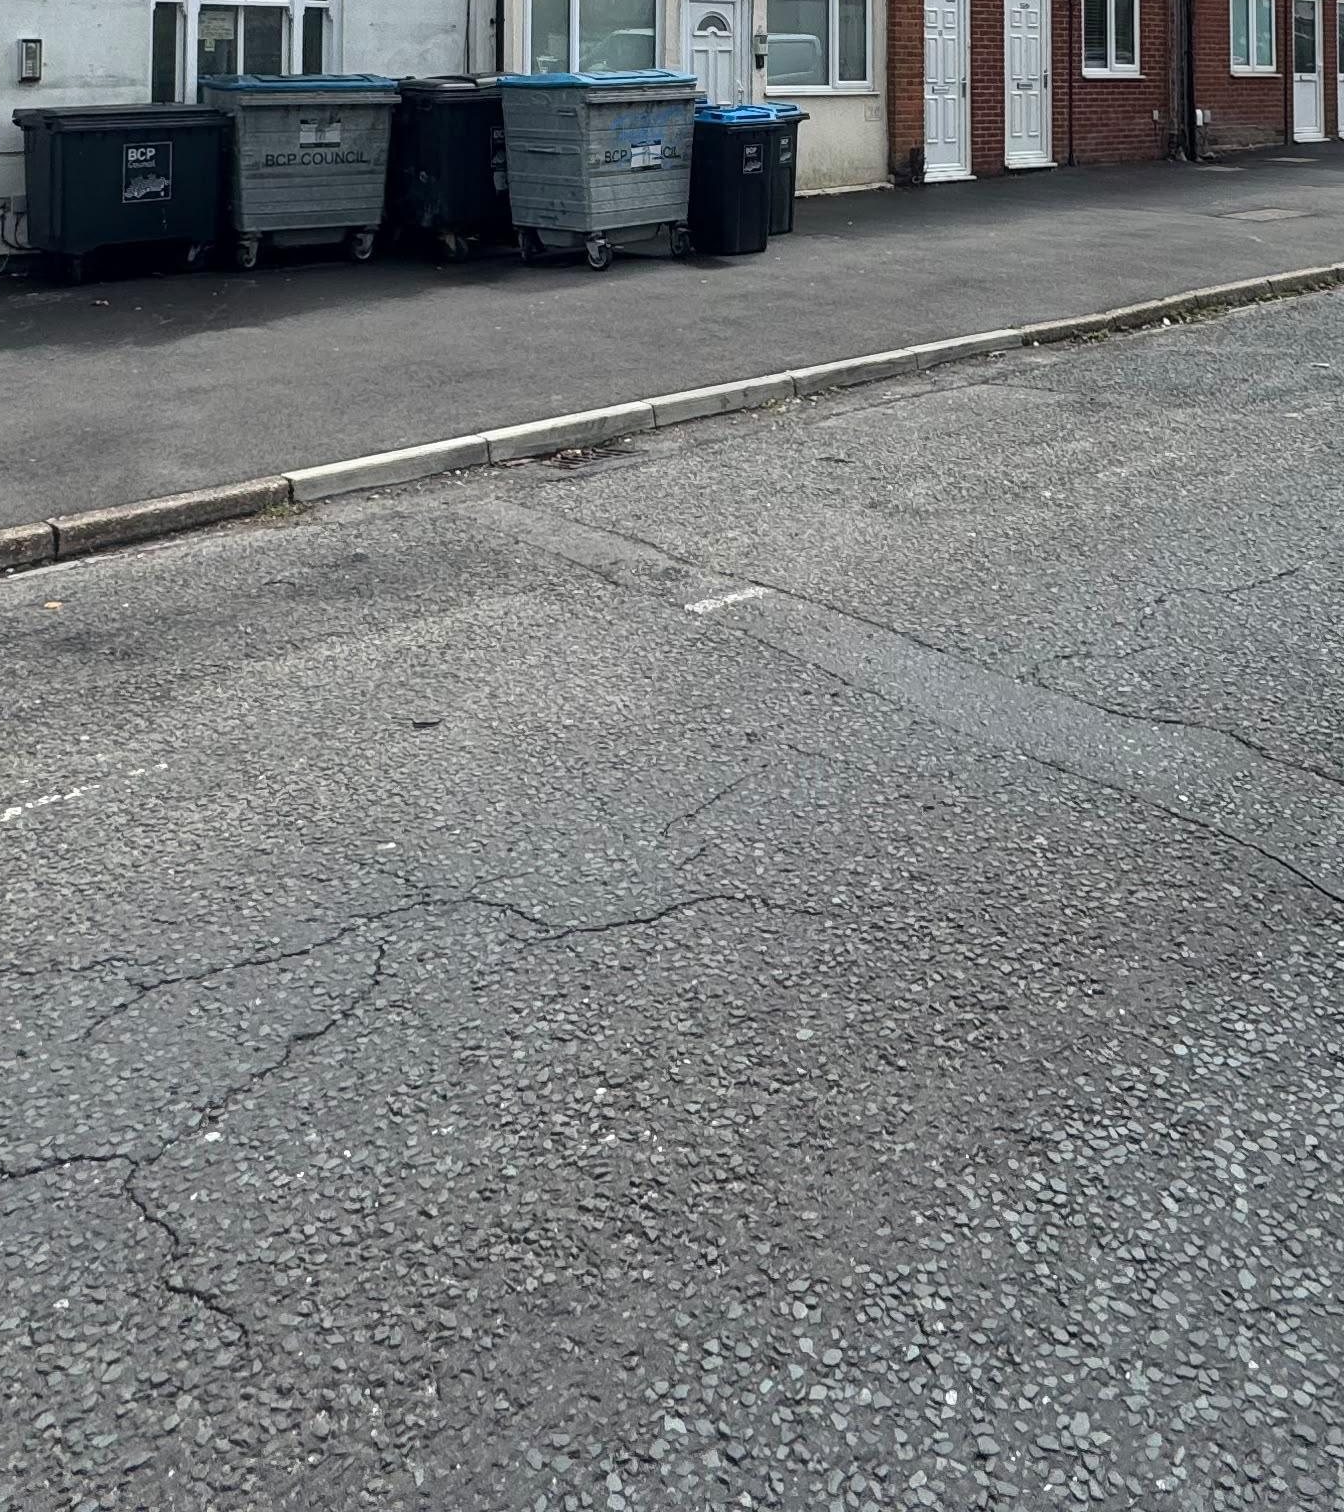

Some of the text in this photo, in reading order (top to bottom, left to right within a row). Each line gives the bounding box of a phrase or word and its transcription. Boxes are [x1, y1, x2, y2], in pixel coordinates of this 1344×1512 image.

[128, 148, 155, 160] BCP
[265, 151, 370, 167] BCP COUNCIL
[605, 149, 627, 163] BCP
